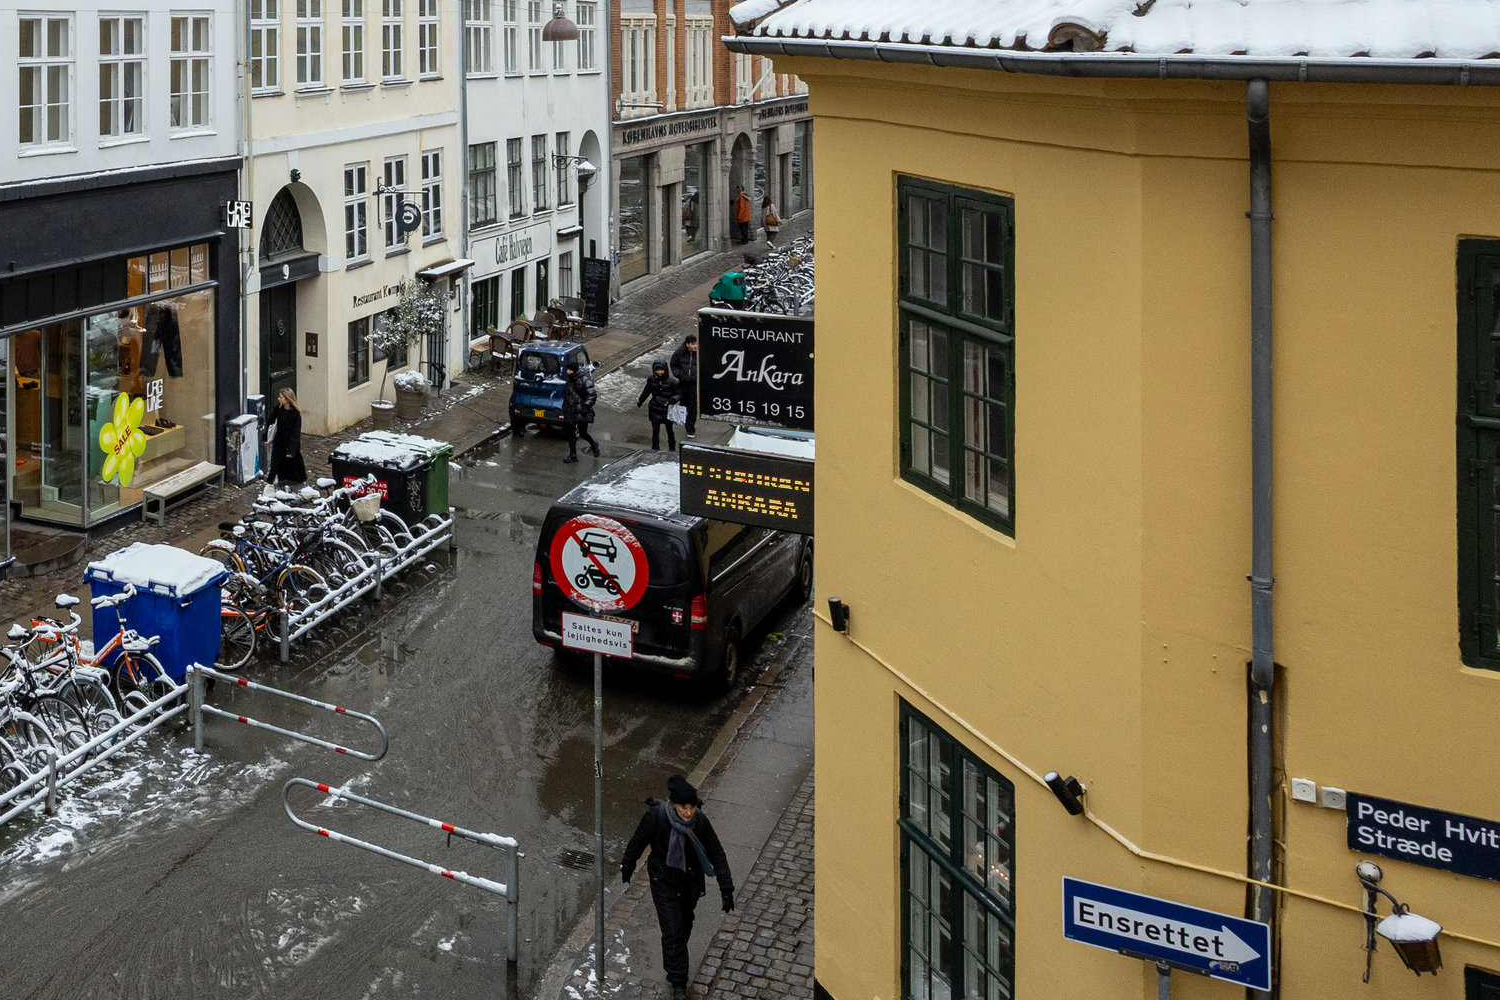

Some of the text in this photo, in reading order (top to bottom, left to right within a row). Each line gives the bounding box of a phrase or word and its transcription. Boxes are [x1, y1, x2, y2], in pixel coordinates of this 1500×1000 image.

[622, 124, 667, 144] KØBENHAVNS
[495, 236, 508, 265] Café
[283, 264, 290, 280] 9
[353, 290, 382, 308] Restaurant
[712, 326, 804, 344] RESTAURANT
[712, 350, 804, 391] Ankara
[712, 397, 805, 418] 33 15 19 15
[114, 426, 132, 455] SALE
[567, 630, 628, 649] lejlighedsvis
[572, 622, 602, 634] Saltes
[606, 627, 623, 638] kun
[1358, 802, 1500, 849] Peder Hvit
[1358, 826, 1453, 862] Stræde
[1079, 902, 1224, 957] Ensrettet
